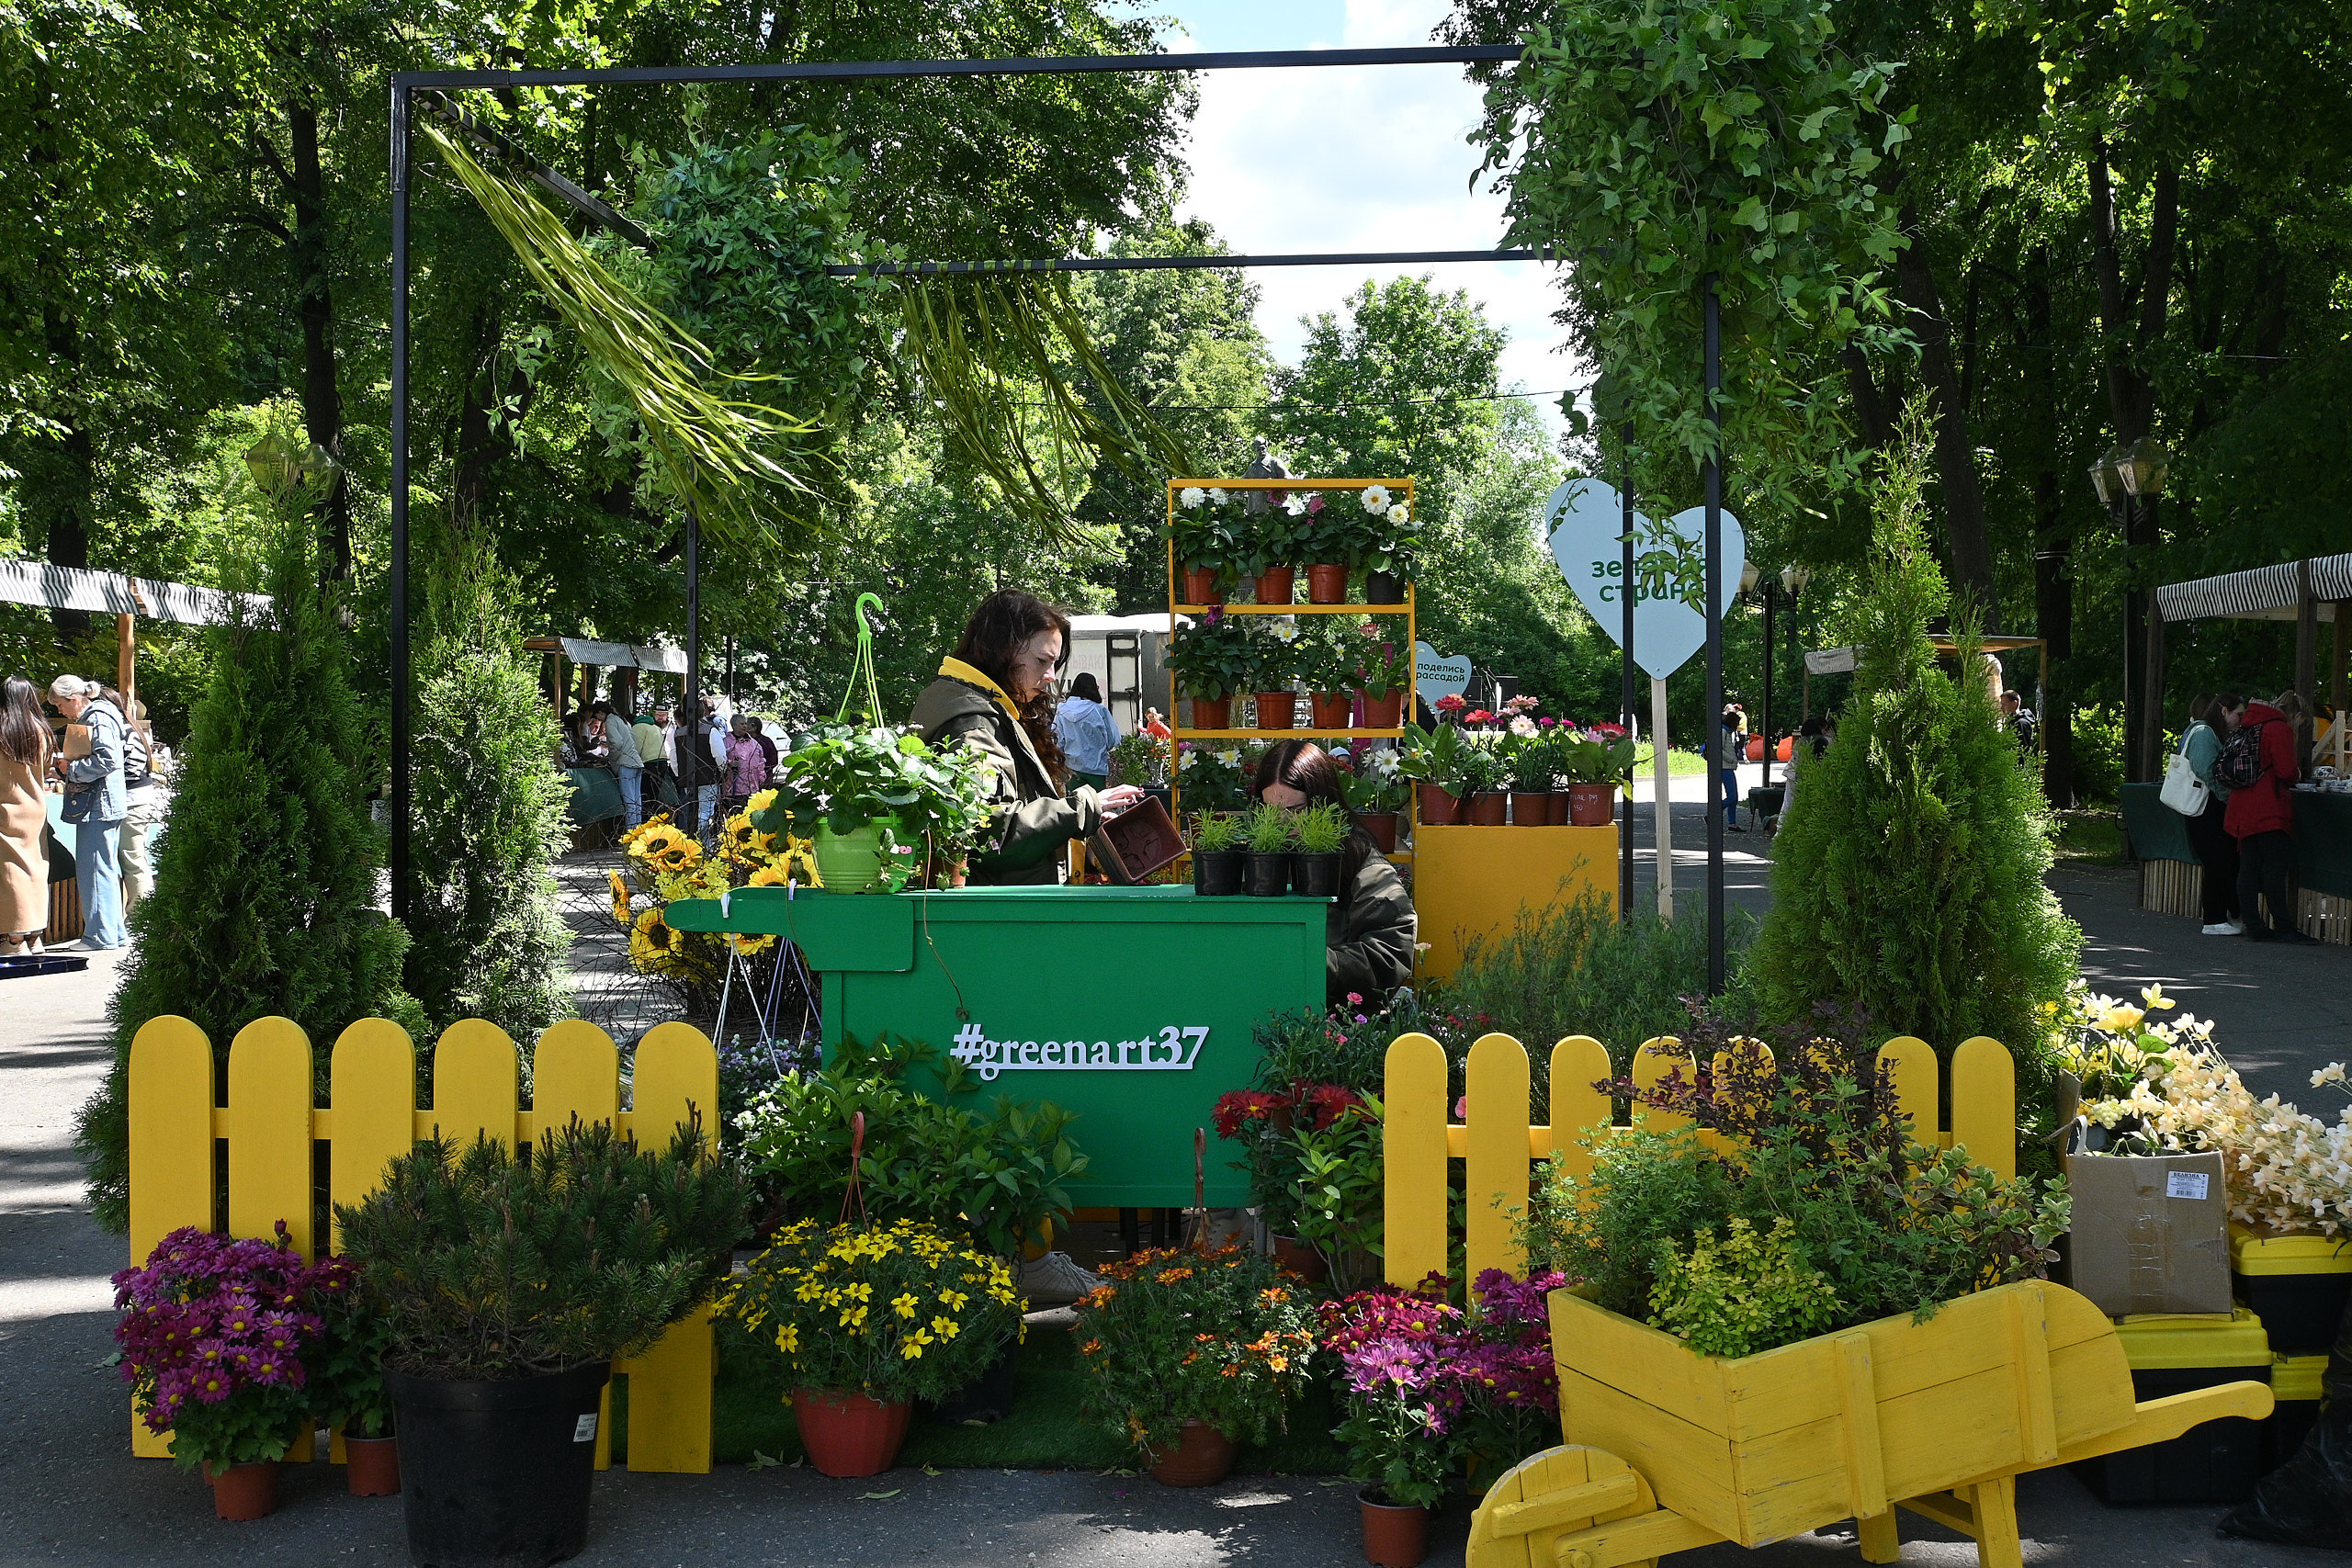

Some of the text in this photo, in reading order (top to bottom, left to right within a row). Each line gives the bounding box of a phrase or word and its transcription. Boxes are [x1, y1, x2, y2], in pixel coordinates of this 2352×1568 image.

[1418, 663, 1465, 673] поделись
[1416, 671, 1465, 682] рассадой
[950, 1023, 1210, 1081] #greenart37
